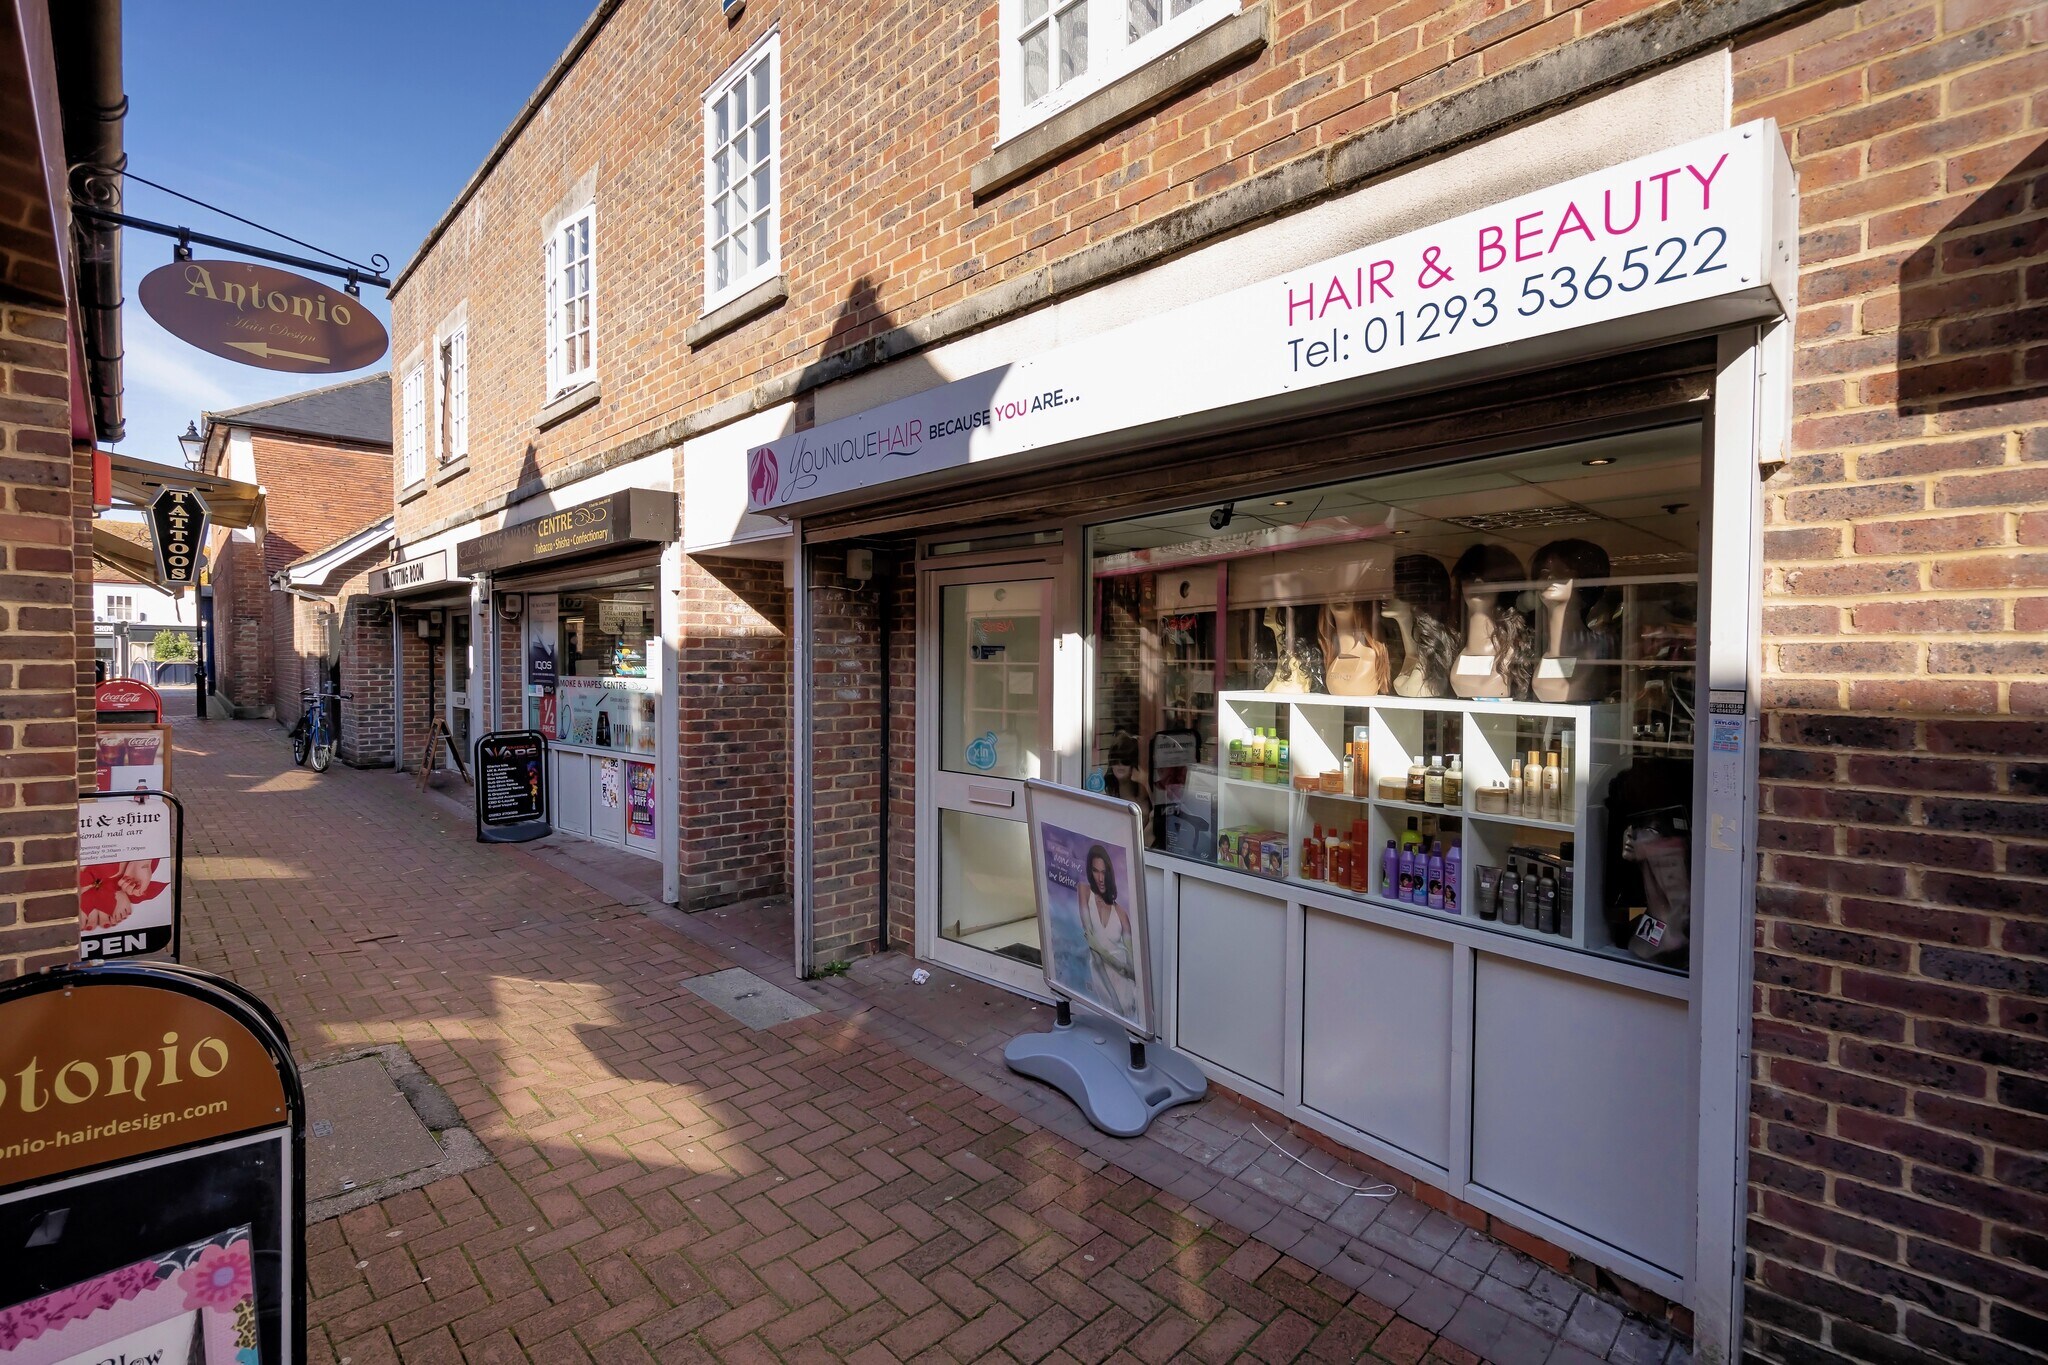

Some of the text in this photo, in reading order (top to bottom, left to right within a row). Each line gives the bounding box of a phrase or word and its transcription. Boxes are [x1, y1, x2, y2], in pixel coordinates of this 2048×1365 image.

[1288, 153, 1729, 326] HAIR & BEAUTY
[184, 264, 351, 326] Antonio
[1287, 226, 1728, 372] Tel: 01293 536522
[227, 315, 317, 343] Hair Design
[929, 409, 991, 441] BECAUSE
[995, 399, 1028, 423] YOU
[1031, 388, 1081, 413] ARE...
[168, 490, 190, 581] TATTOOS
[538, 511, 573, 538] CENTRE
[535, 529, 609, 554] Tobacco Shisha Confectionary
[409, 562, 425, 583] ROOM
[534, 660, 552, 671] IQOS
[100, 692, 142, 703] Coca-Cola
[560, 679, 576, 688] MOKE
[583, 680, 602, 689] VAPES
[603, 680, 627, 690] CENTRE
[485, 745, 537, 758] VAPE
[97, 814, 114, 828] &
[117, 811, 161, 827] shine
[107, 828, 123, 838] nail
[80, 932, 147, 959] PEN
[0, 1031, 229, 1113] tonio
